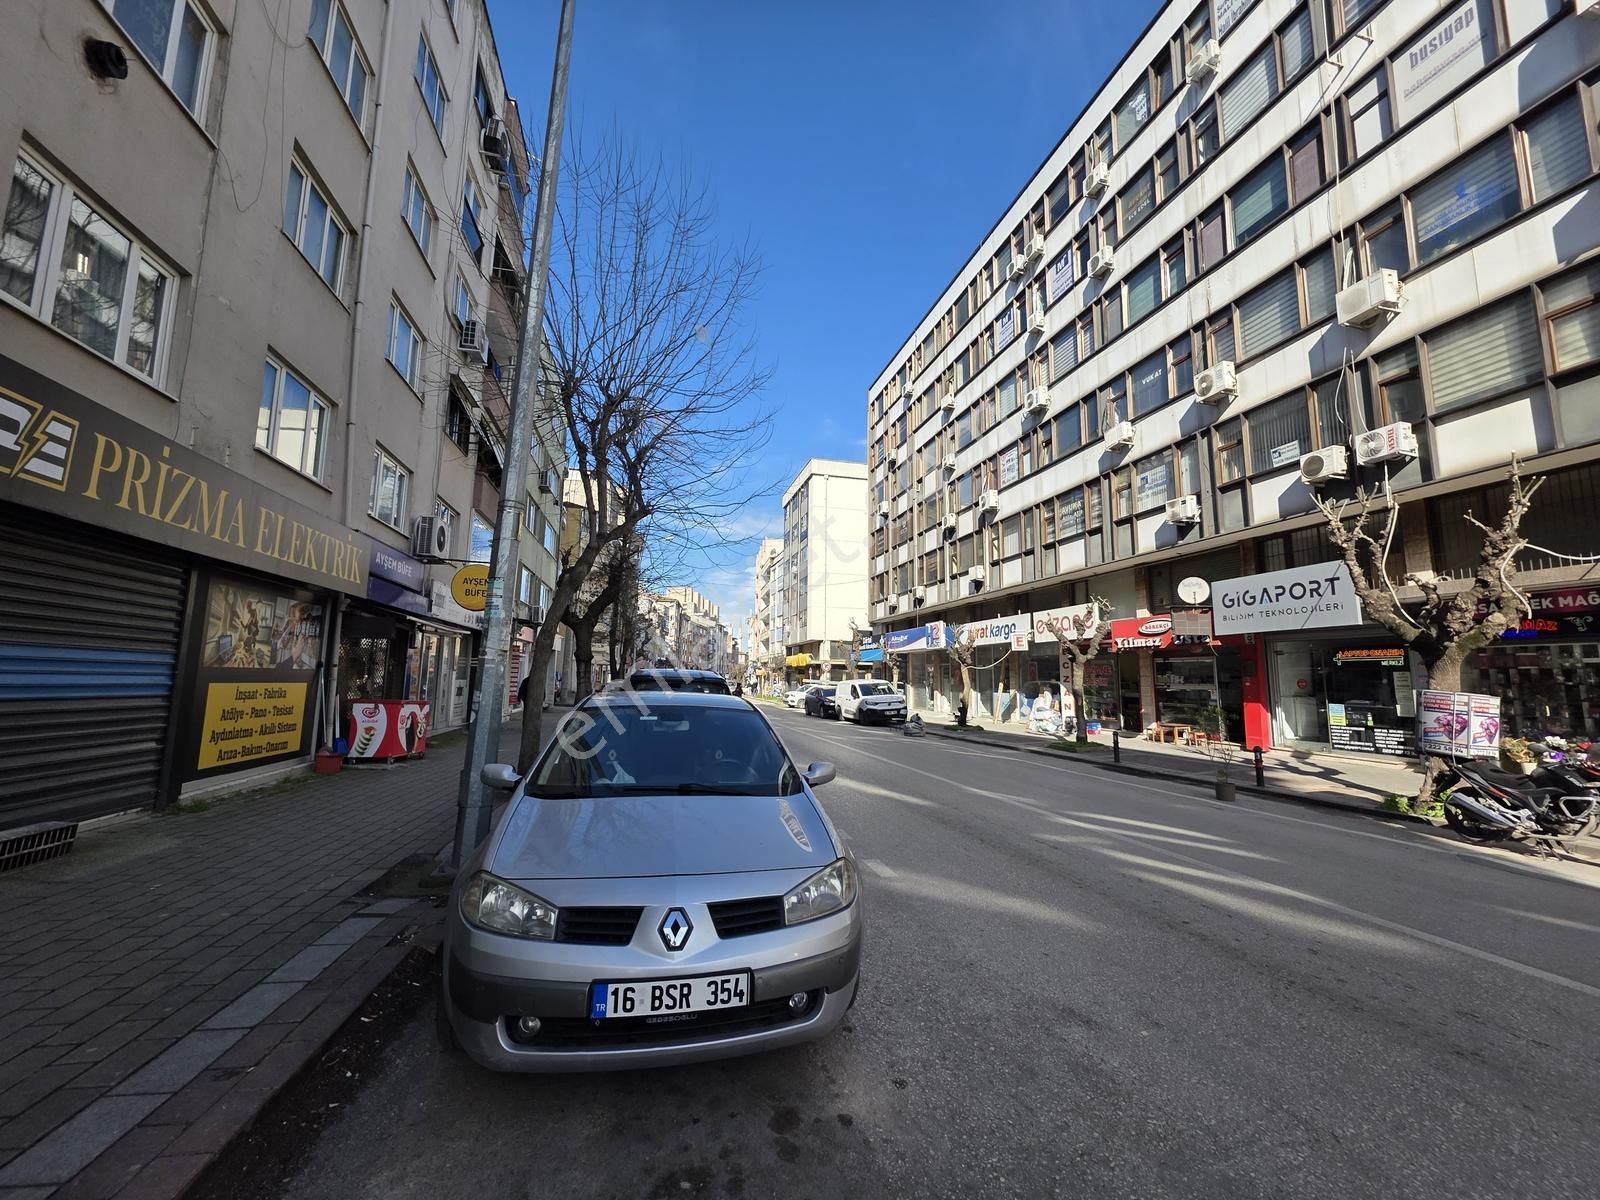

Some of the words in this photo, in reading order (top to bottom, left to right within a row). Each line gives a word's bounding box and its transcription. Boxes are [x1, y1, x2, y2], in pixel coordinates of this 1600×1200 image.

[1387, 427, 1395, 451] VESTEL
[82, 433, 246, 547] PRİZMA
[255, 506, 363, 584] ELEKTRİK
[375, 551, 397, 571] AYŞEM
[397, 561, 412, 577] BÜFE
[1016, 637, 1025, 647] E
[1115, 636, 1162, 648] Yılmaz
[235, 686, 258, 703] İnşaat
[264, 687, 287, 699] Fabrika
[220, 708, 245, 723] Atölye
[250, 706, 267, 719] Pano
[272, 705, 294, 717] Tesisat
[209, 727, 253, 745] Aydınlatma
[259, 723, 277, 736] Akıllı
[277, 722, 297, 733] Sistem
[610, 987, 636, 1013] 16
[650, 982, 691, 1012] BSR
[706, 978, 745, 1006] 354
[595, 1003, 606, 1013] TR
